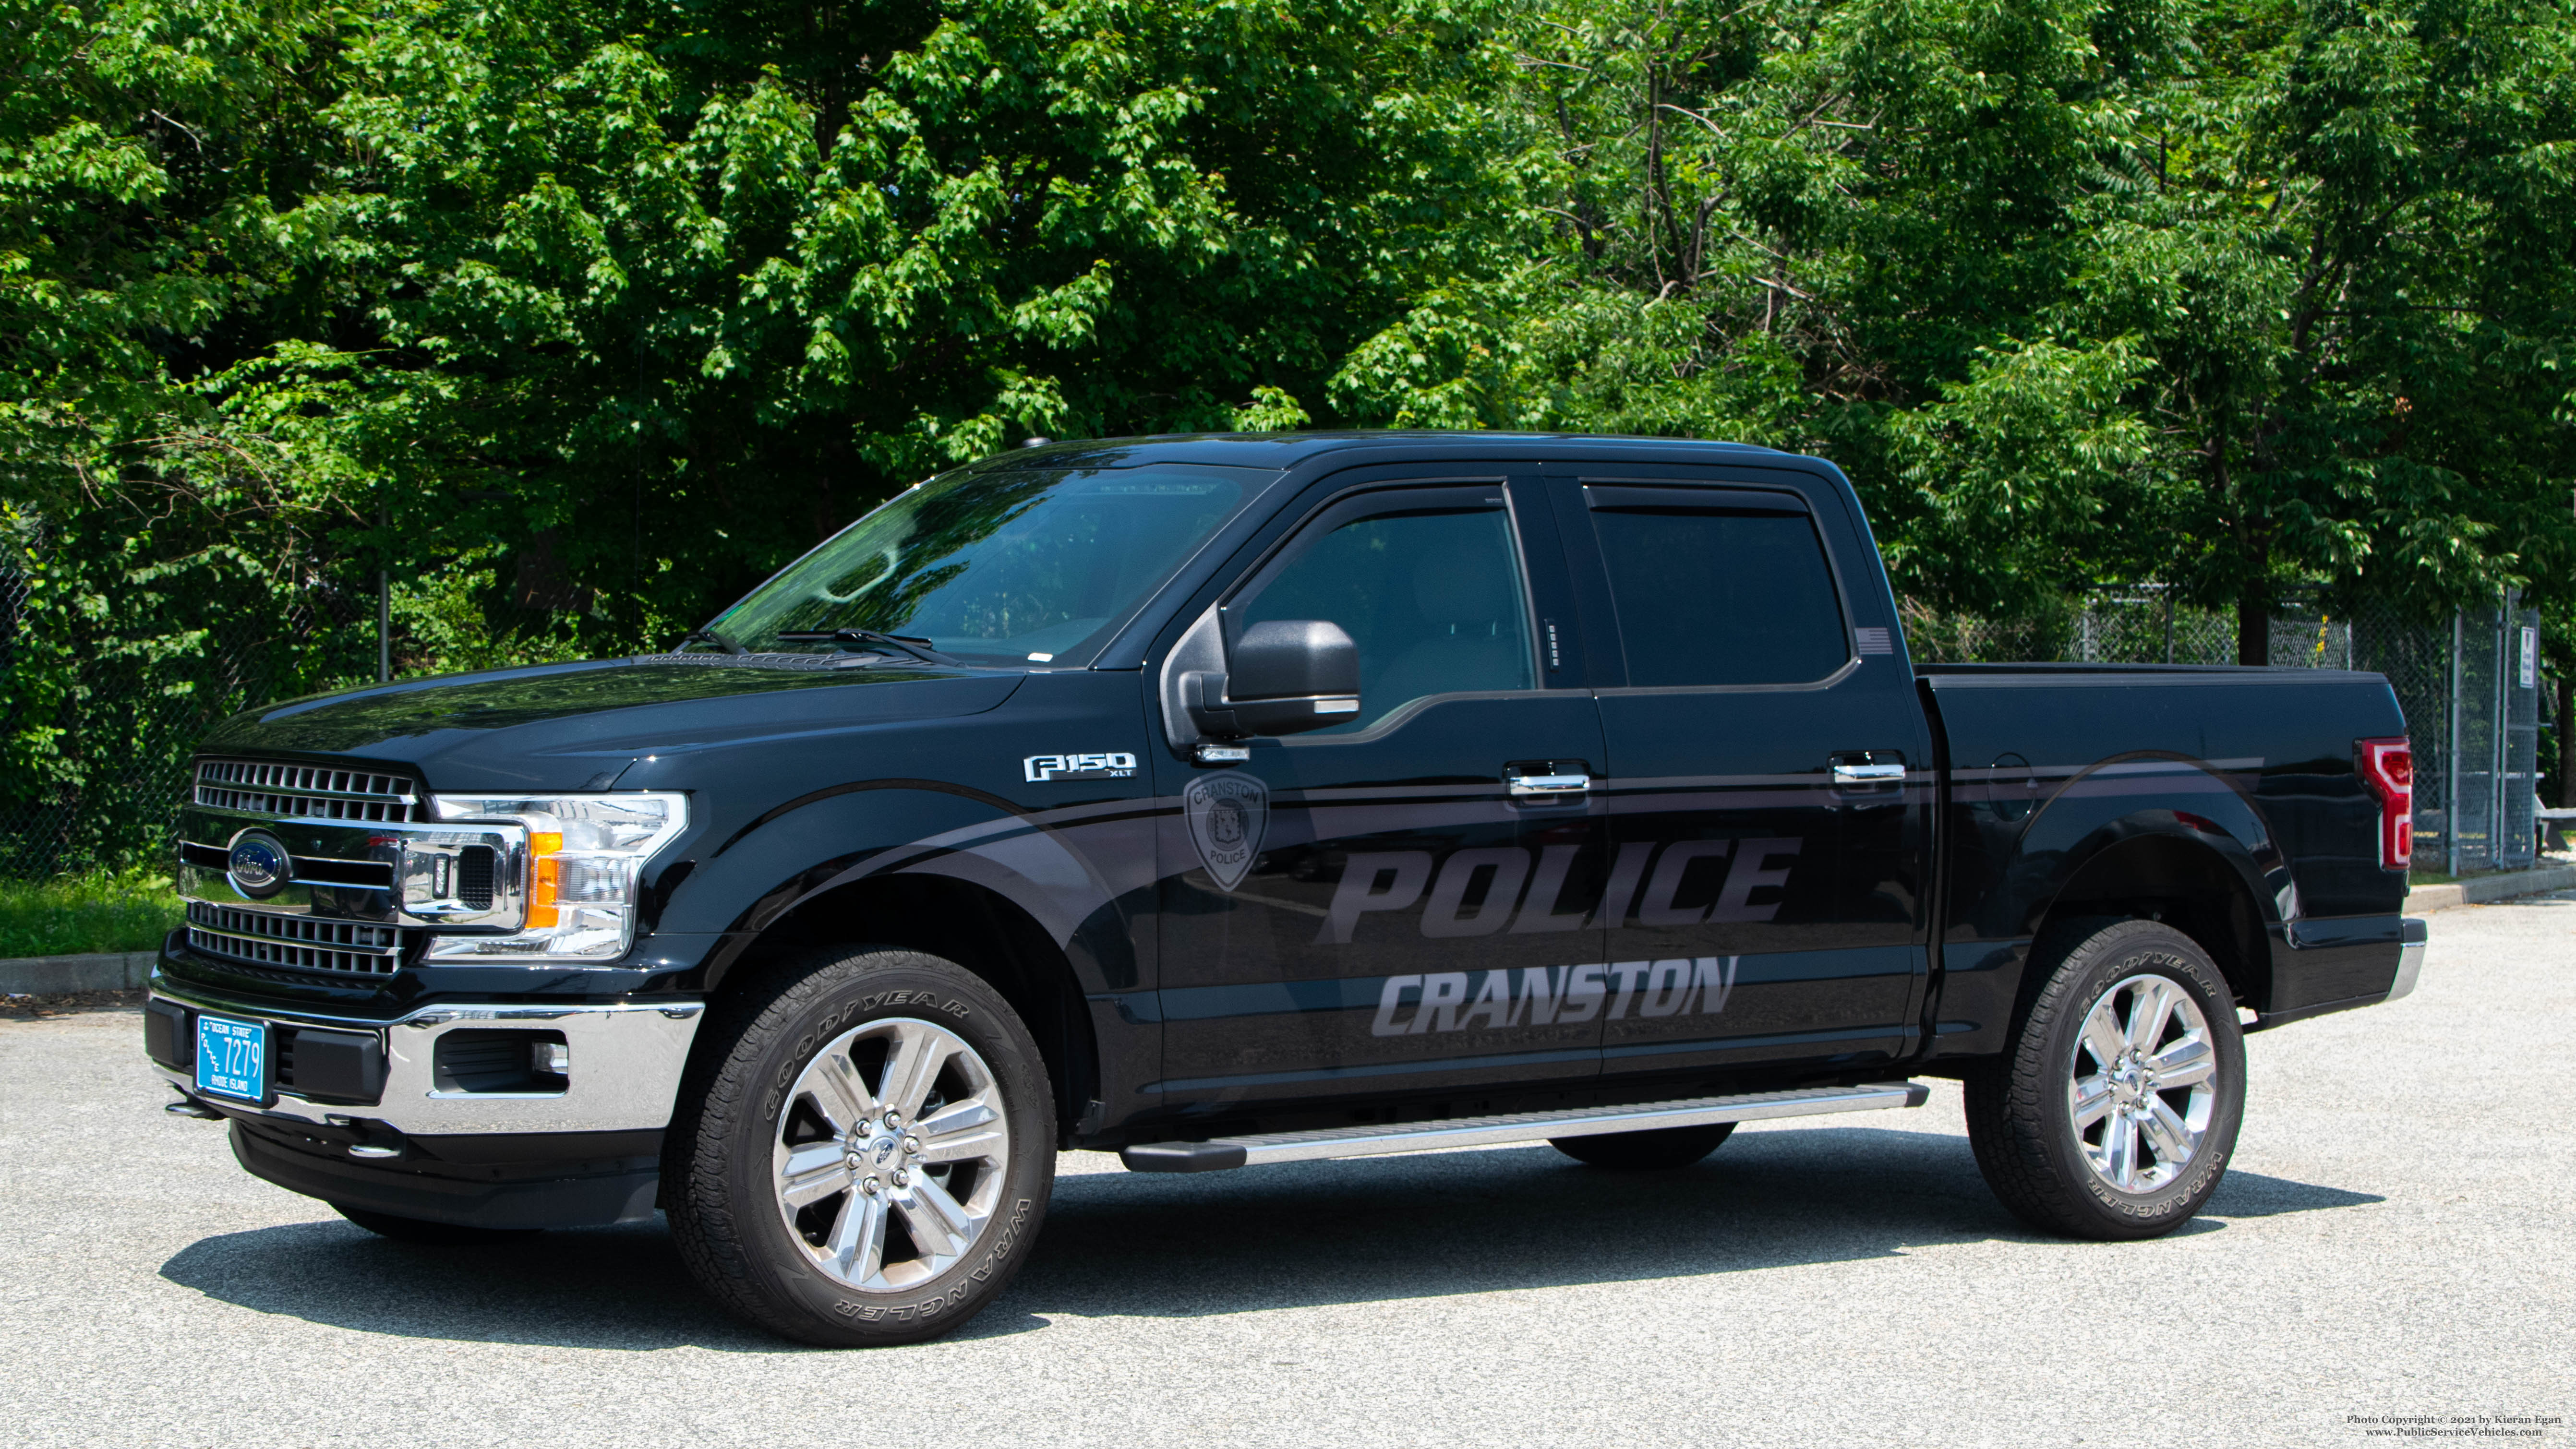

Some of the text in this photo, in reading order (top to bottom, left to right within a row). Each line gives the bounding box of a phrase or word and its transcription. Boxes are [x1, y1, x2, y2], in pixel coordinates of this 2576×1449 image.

[1194, 781, 1258, 804] CRANSTON
[236, 849, 271, 876] Ford
[1210, 849, 1246, 864] POLICE
[1312, 837, 1803, 945] POLICE
[1371, 955, 1740, 1037] CRANSTON
[2079, 952, 2217, 1021] GOODYEAR
[201, 1033, 219, 1072] POLICE
[224, 1037, 260, 1078] 7279
[764, 990, 969, 1120] GOODYEAR
[211, 1075, 248, 1092] RHODE ISLAND
[2088, 1152, 2222, 1218] WRANGLER
[834, 1198, 1032, 1322] WRANGLER
